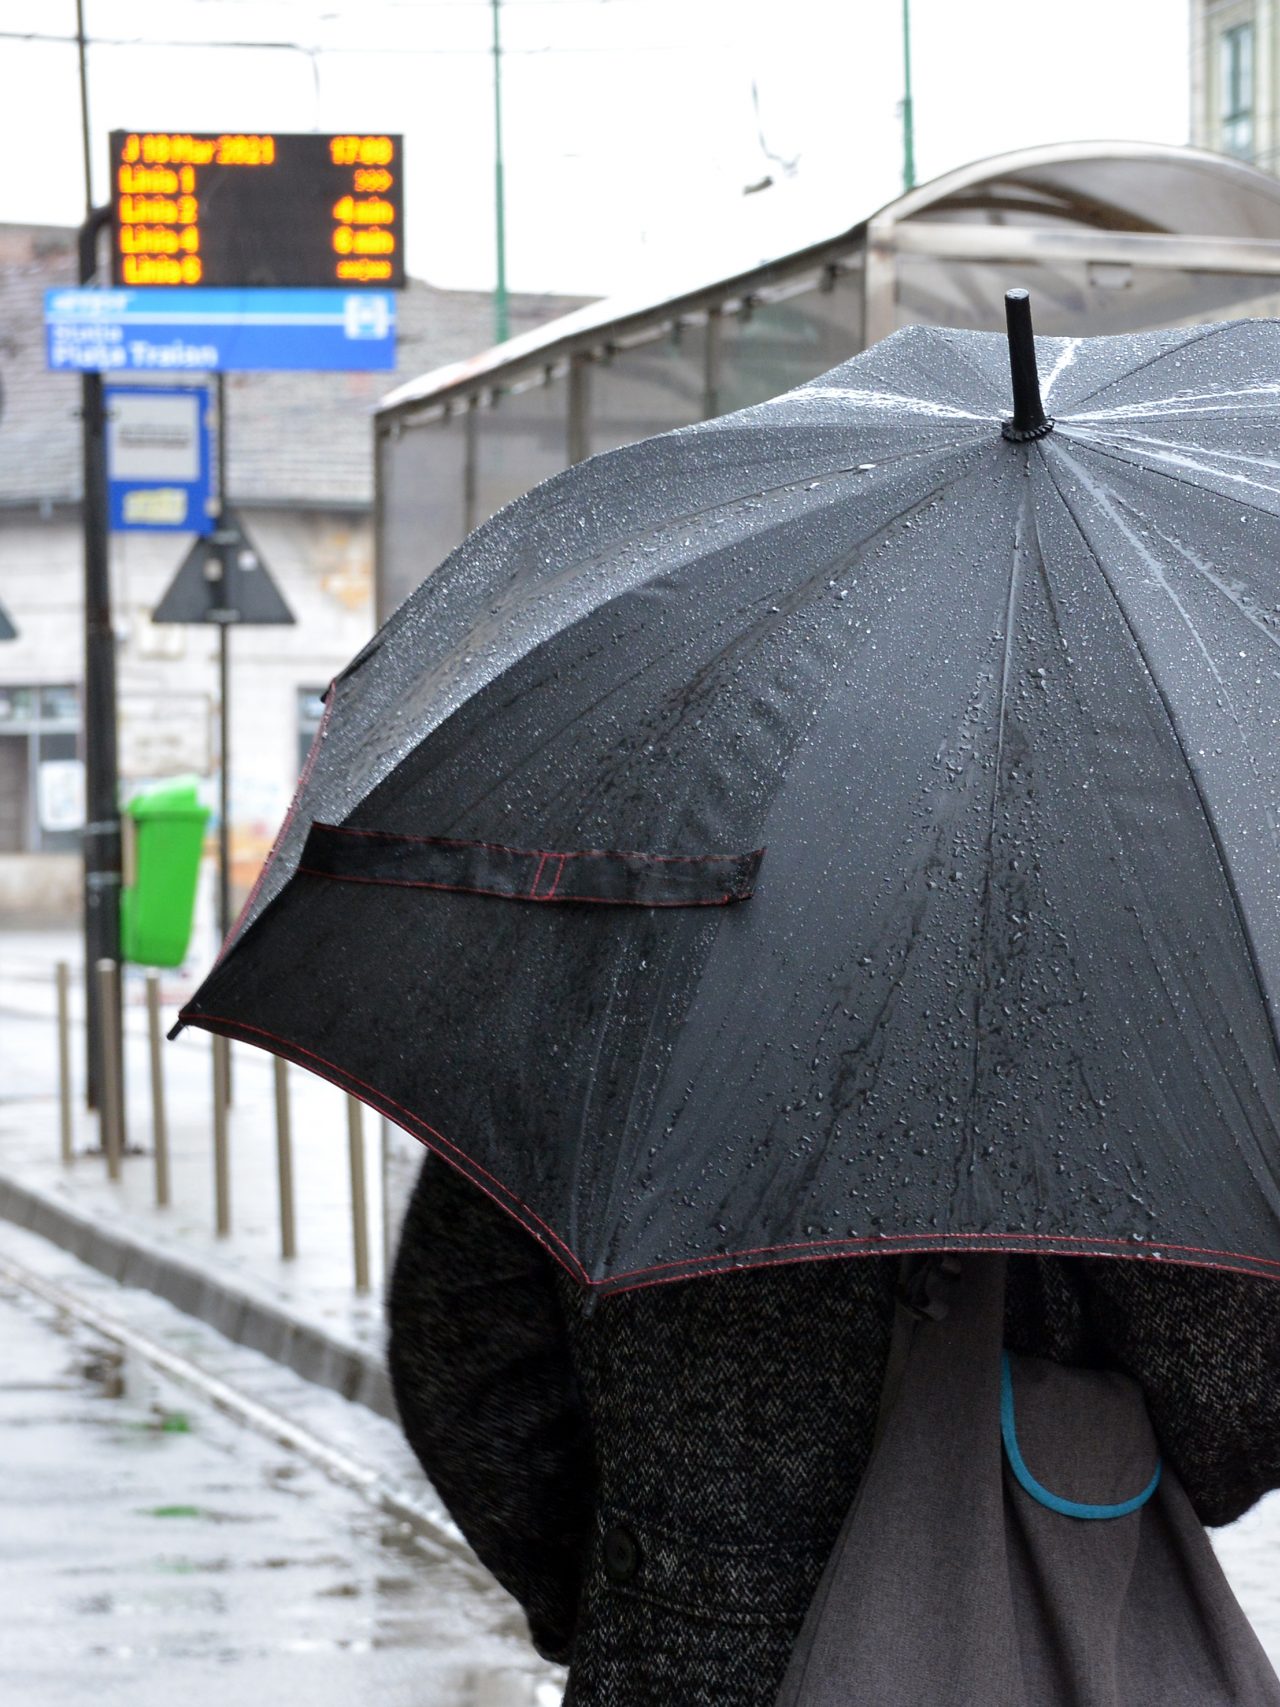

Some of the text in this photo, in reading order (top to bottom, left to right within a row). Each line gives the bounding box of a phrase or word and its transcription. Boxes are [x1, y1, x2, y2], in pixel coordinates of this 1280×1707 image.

[118, 164, 179, 194] Linia
[180, 164, 195, 194] 1
[118, 194, 179, 224] Linia
[178, 194, 198, 224] 2
[333, 195, 353, 224] 4
[120, 224, 180, 254] Linia
[122, 254, 182, 285] Linia
[130, 339, 219, 369] Traian
